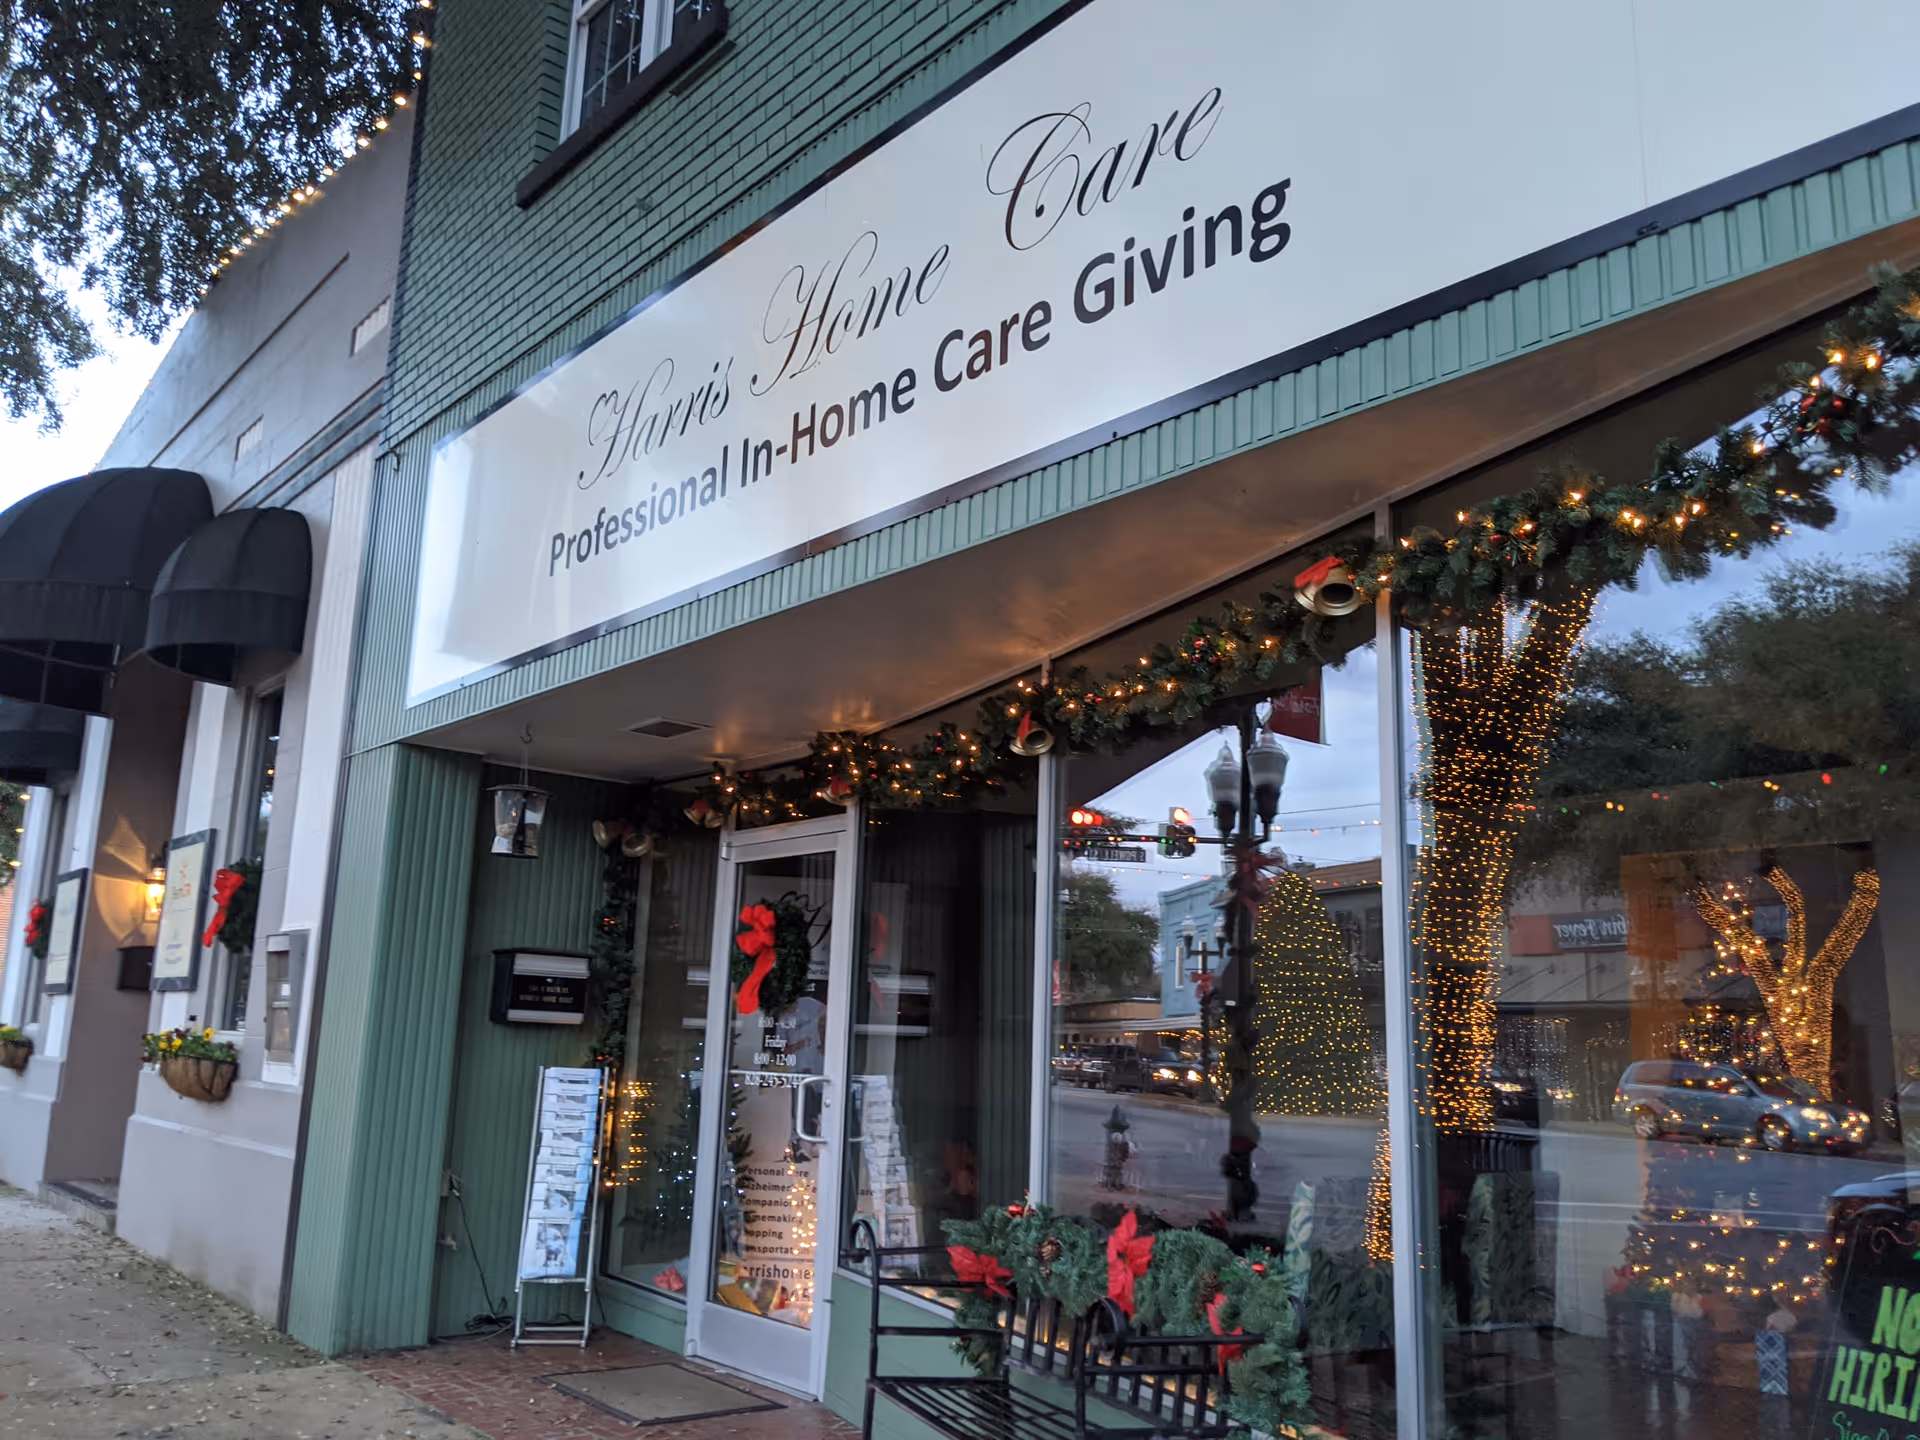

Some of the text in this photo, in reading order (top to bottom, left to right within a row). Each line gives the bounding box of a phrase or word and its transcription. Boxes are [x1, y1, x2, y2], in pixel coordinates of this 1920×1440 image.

[548, 177, 1292, 577] Professional In-Home Care Giving
[578, 86, 1222, 491] Harris Home Care
[748, 1167, 784, 1177] ersonal
